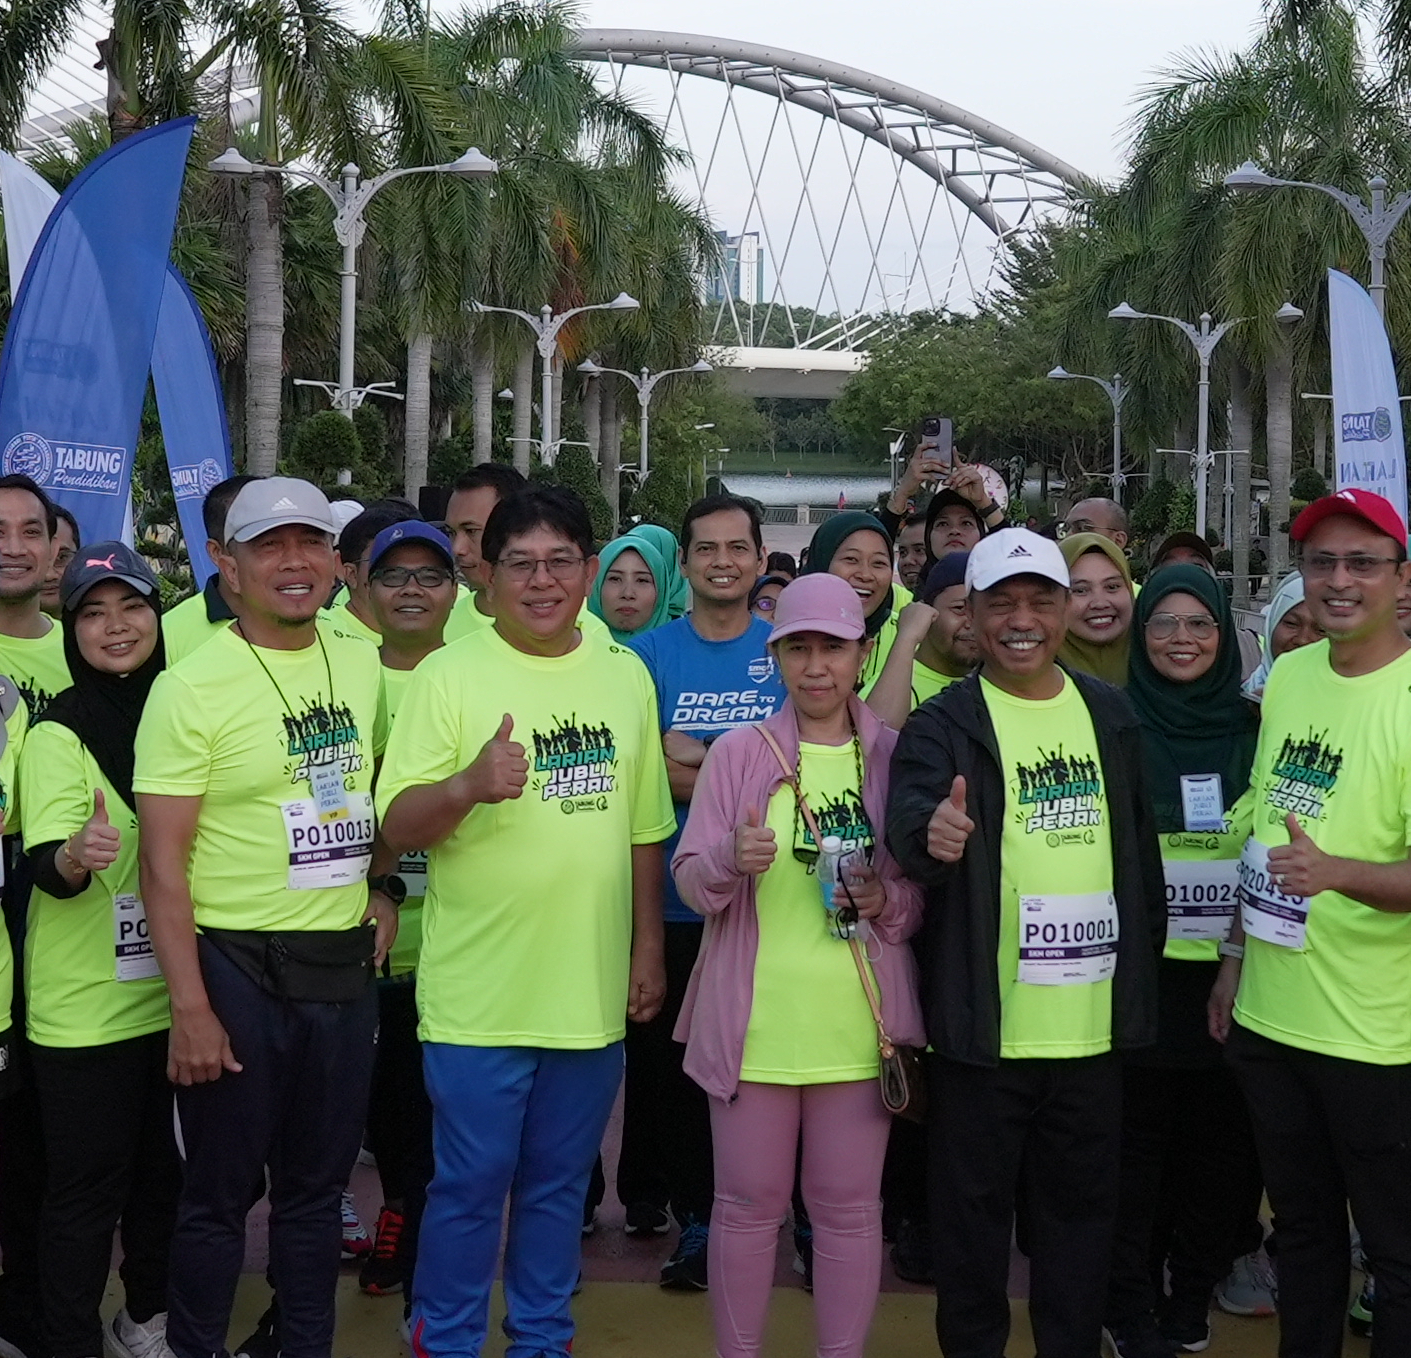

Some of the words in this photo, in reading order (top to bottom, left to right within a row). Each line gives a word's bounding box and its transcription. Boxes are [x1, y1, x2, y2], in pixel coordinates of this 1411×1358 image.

[56, 447, 121, 474] TABUNG
[52, 468, 119, 490] Pendidikan
[677, 690, 759, 707] DARE
[671, 705, 774, 722] DREAM
[287, 725, 359, 756] LARIAN
[534, 745, 616, 772] LARIAN
[547, 761, 608, 784] JUBLI
[1271, 760, 1338, 791] LARIAN
[541, 775, 616, 801] PERAK
[1018, 779, 1101, 805] LARIAN
[1273, 777, 1324, 804] JUBLI
[1032, 794, 1094, 818] JUBLI
[1266, 789, 1324, 819] PERAK
[1025, 809, 1101, 834] PERAK
